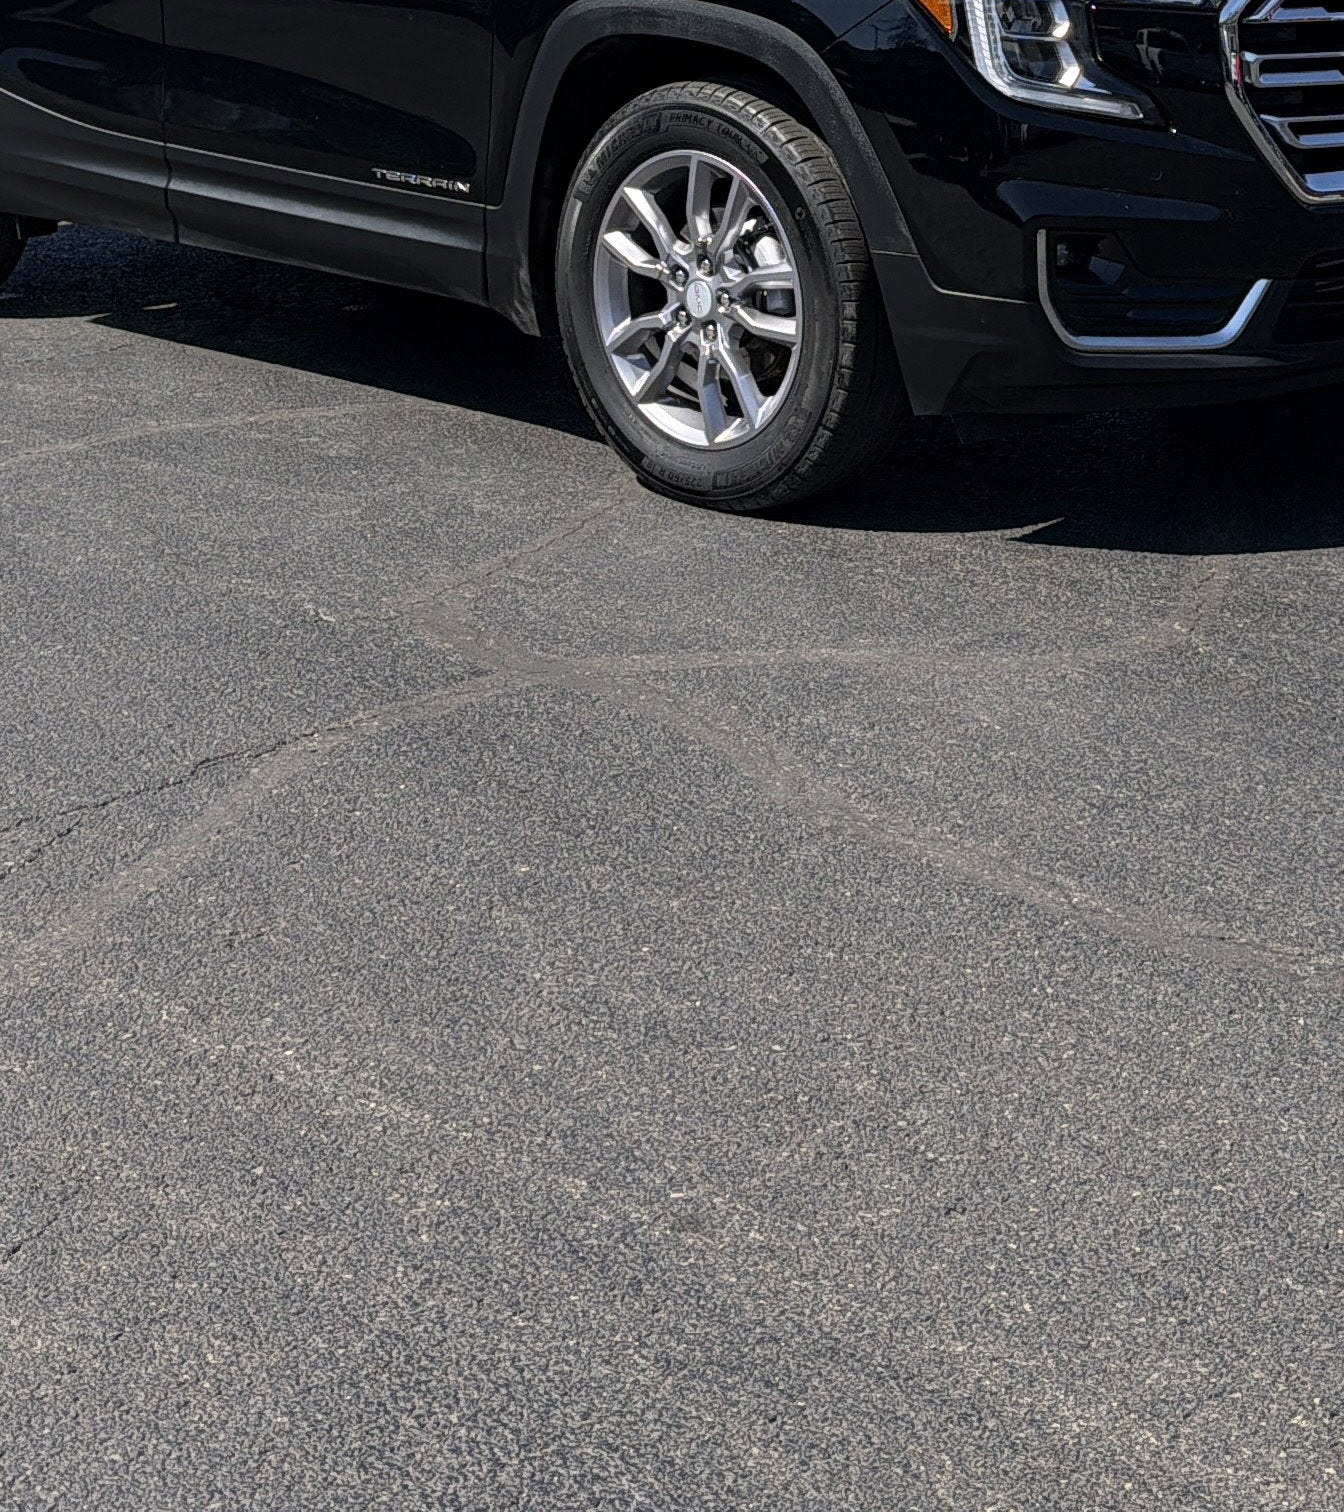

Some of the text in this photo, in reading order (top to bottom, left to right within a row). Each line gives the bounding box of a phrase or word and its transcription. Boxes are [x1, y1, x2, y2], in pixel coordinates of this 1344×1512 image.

[668, 112, 713, 130] PRIMACY
[371, 168, 470, 193] TERRAIN
[694, 282, 703, 314] GMC
